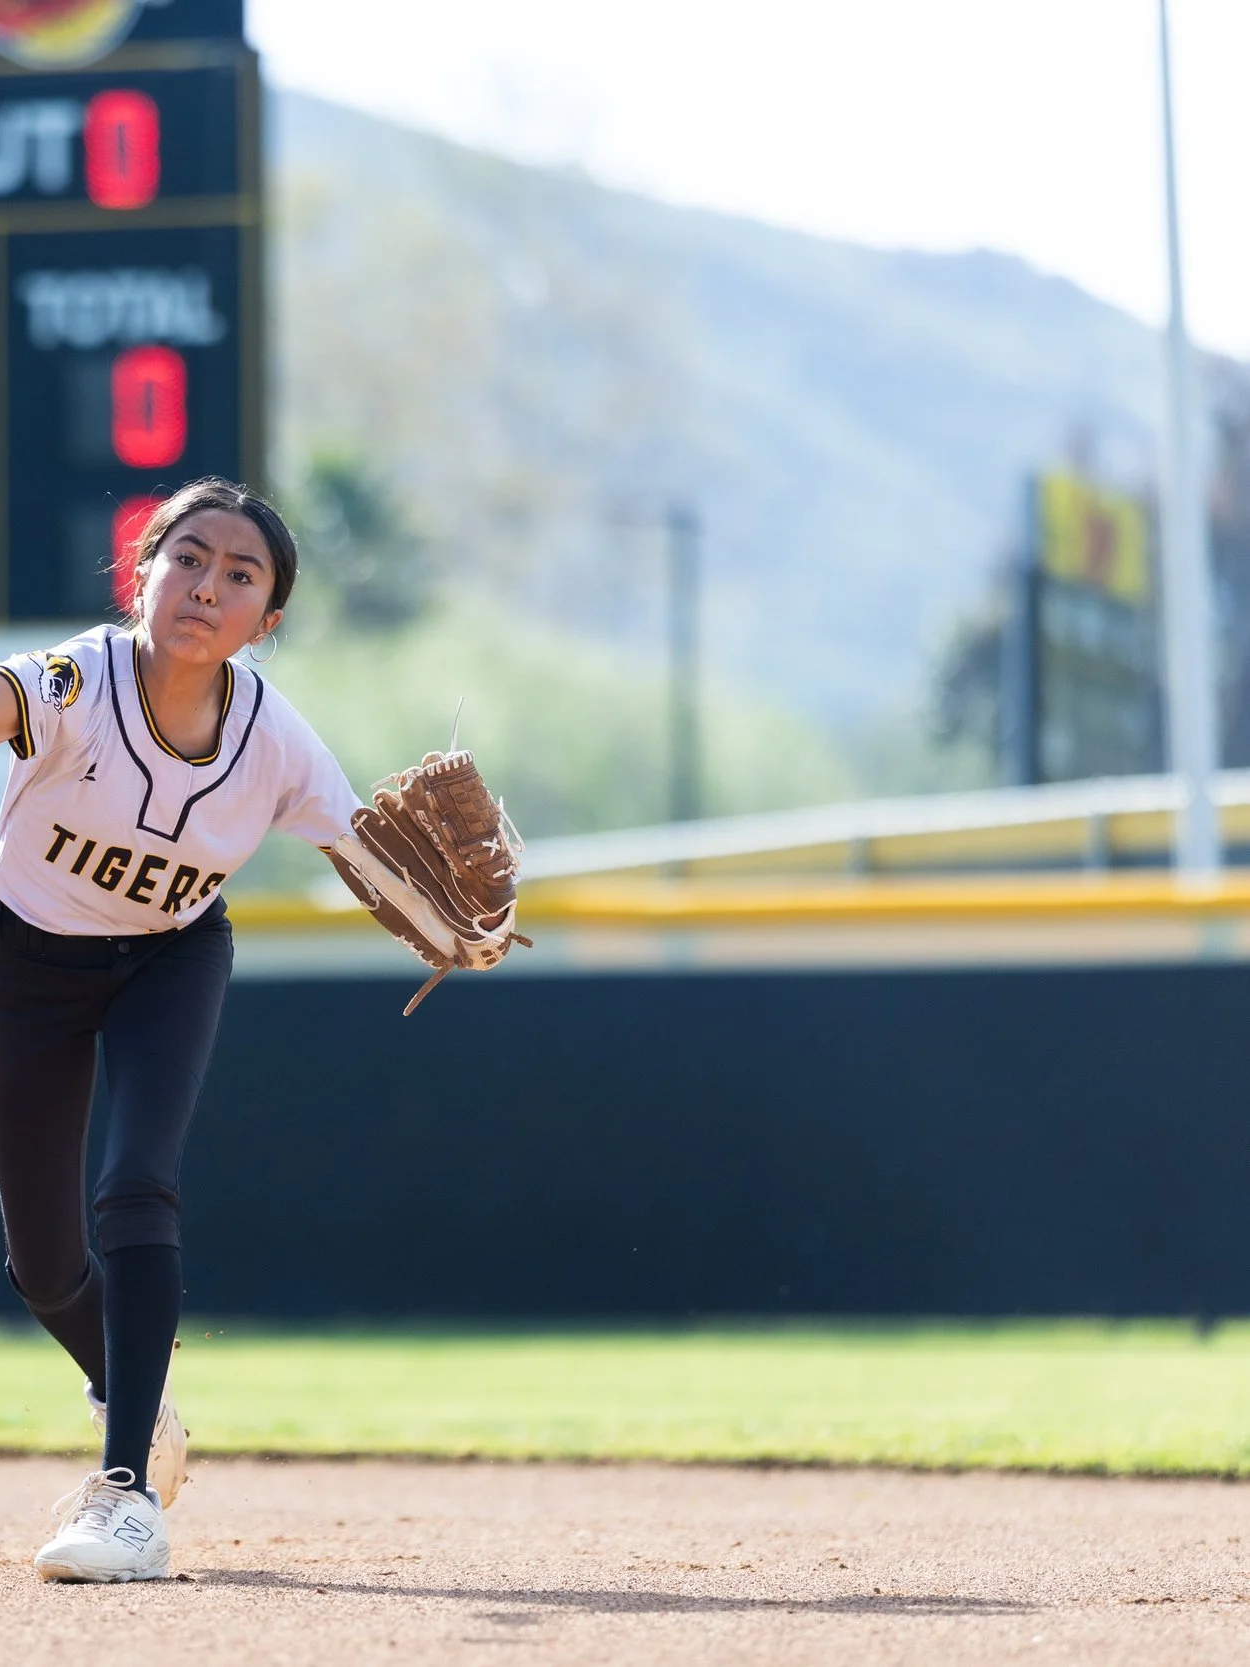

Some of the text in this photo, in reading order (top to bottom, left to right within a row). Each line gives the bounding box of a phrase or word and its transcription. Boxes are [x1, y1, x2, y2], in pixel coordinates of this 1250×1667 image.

[84, 89, 160, 210] 0
[19, 269, 226, 347] TOTAL
[112, 345, 187, 469] 0
[44, 823, 226, 915] TIGERS
